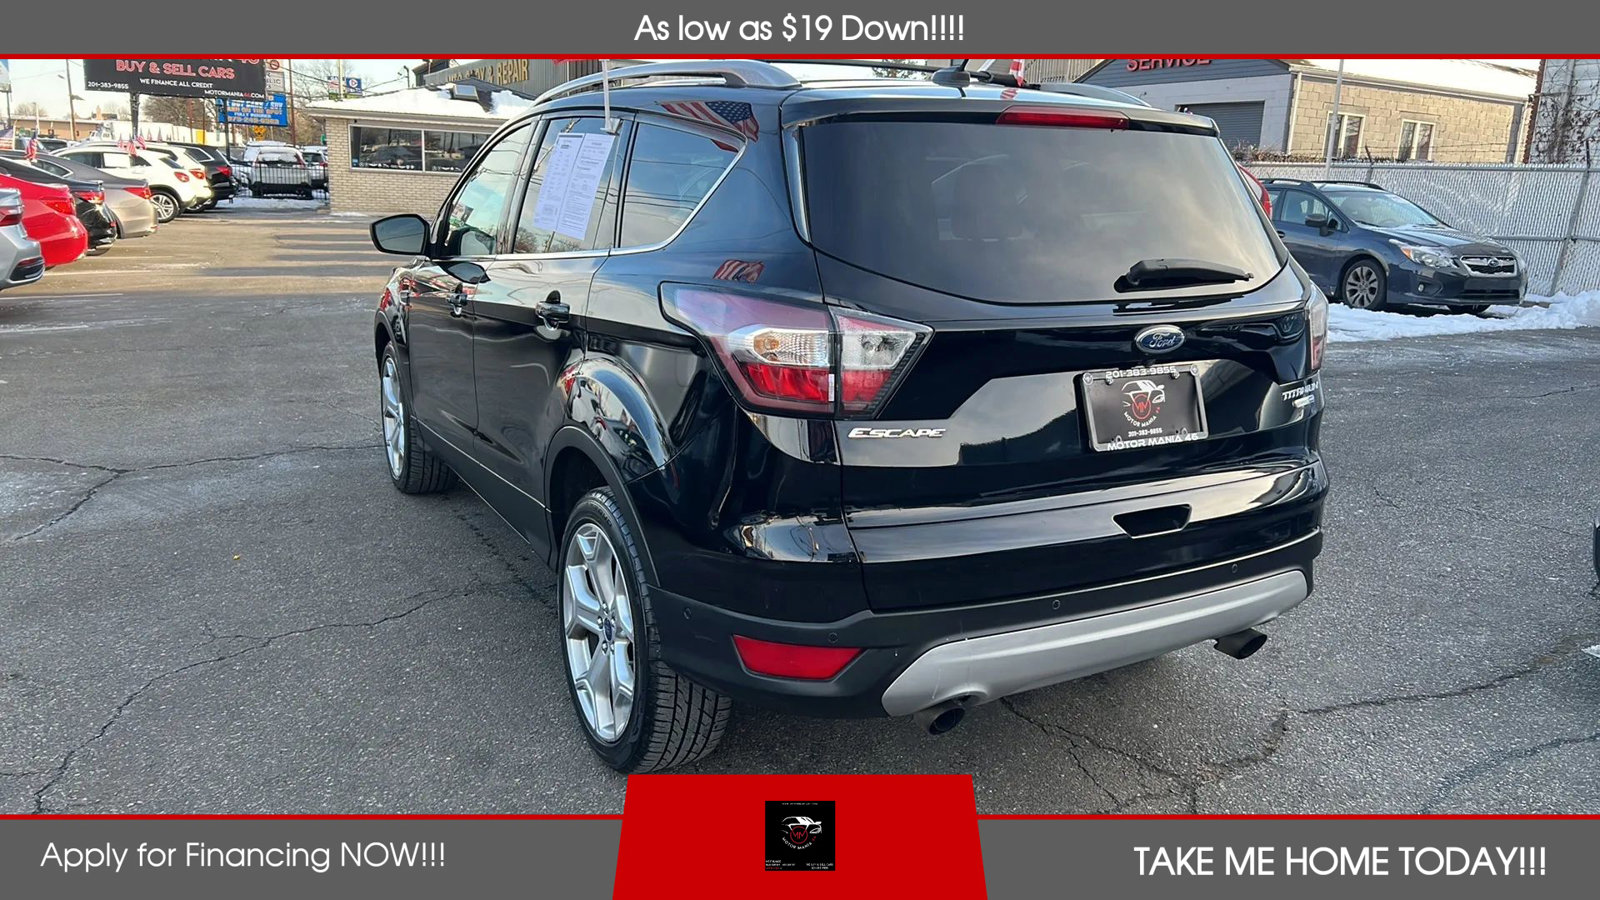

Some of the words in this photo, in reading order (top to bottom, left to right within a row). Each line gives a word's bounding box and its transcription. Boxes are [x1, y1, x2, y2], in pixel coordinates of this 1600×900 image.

[115, 59, 147, 73] BUY
[149, 61, 161, 74] &
[162, 62, 196, 76] SELL
[198, 65, 235, 79] CARS
[496, 59, 529, 85] REPAIR
[87, 81, 129, 89] 201-383-9855
[1148, 333, 1177, 348] Ford
[1105, 366, 1177, 379] 201-383-9855
[1124, 411, 1141, 427] MOTOR
[1141, 415, 1157, 427] MANIA
[847, 427, 946, 440] ESCAPE
[1107, 439, 1147, 451] MOTOR
[1147, 434, 1184, 446] MANIA
[1184, 432, 1199, 442] 46
